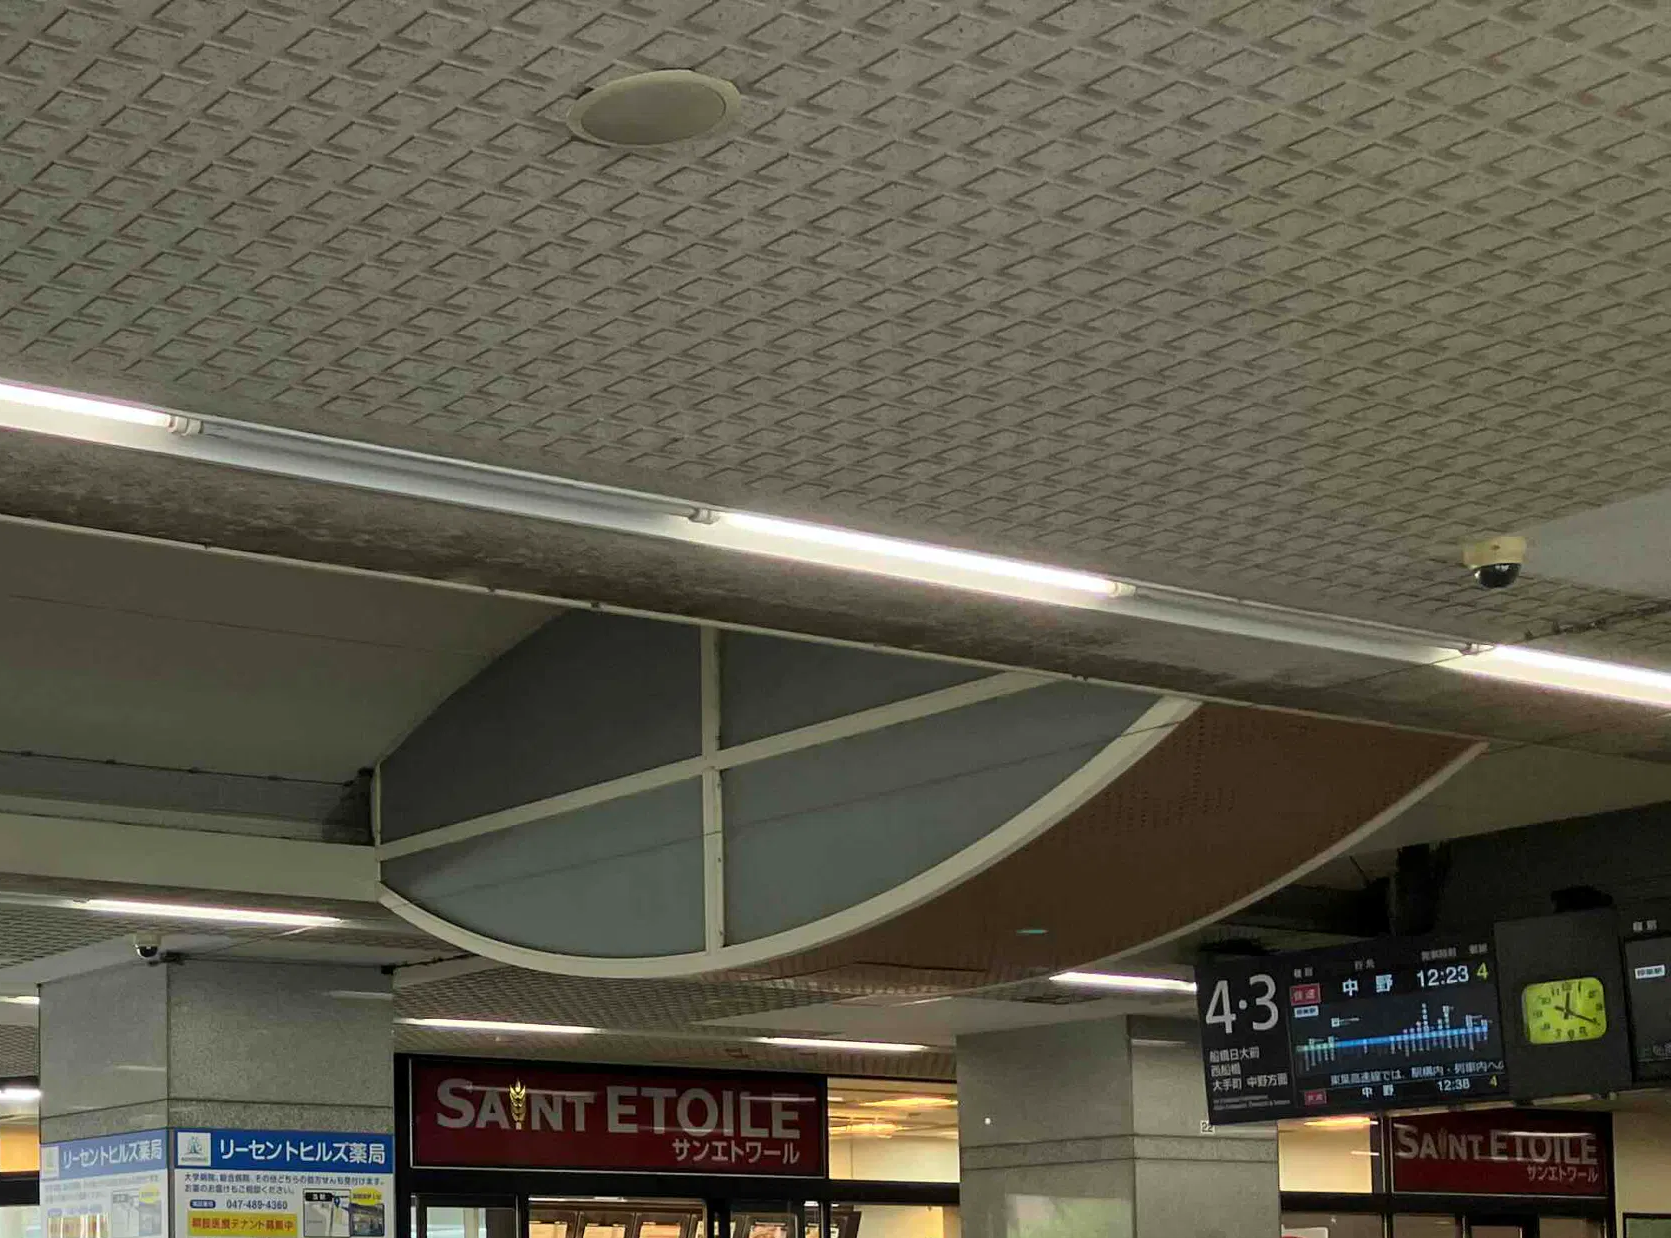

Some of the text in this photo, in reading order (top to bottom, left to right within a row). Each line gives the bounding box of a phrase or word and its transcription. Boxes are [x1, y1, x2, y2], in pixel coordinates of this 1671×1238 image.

[1416, 964, 1470, 988] 12:23
[1476, 961, 1489, 980] 4
[1437, 1077, 1471, 1092] 12:38
[1489, 1075, 1498, 1087] 4
[436, 1076, 801, 1139] SAINT ETOILE
[62, 1138, 163, 1169] リーセントヒルズ薬局
[218, 1138, 386, 1165] リーセントヒルズ薬局
[671, 1137, 800, 1164] サンエトワール
[1393, 1122, 1599, 1165] SAINT ETOILE
[1527, 1164, 1599, 1183] サンエトワール
